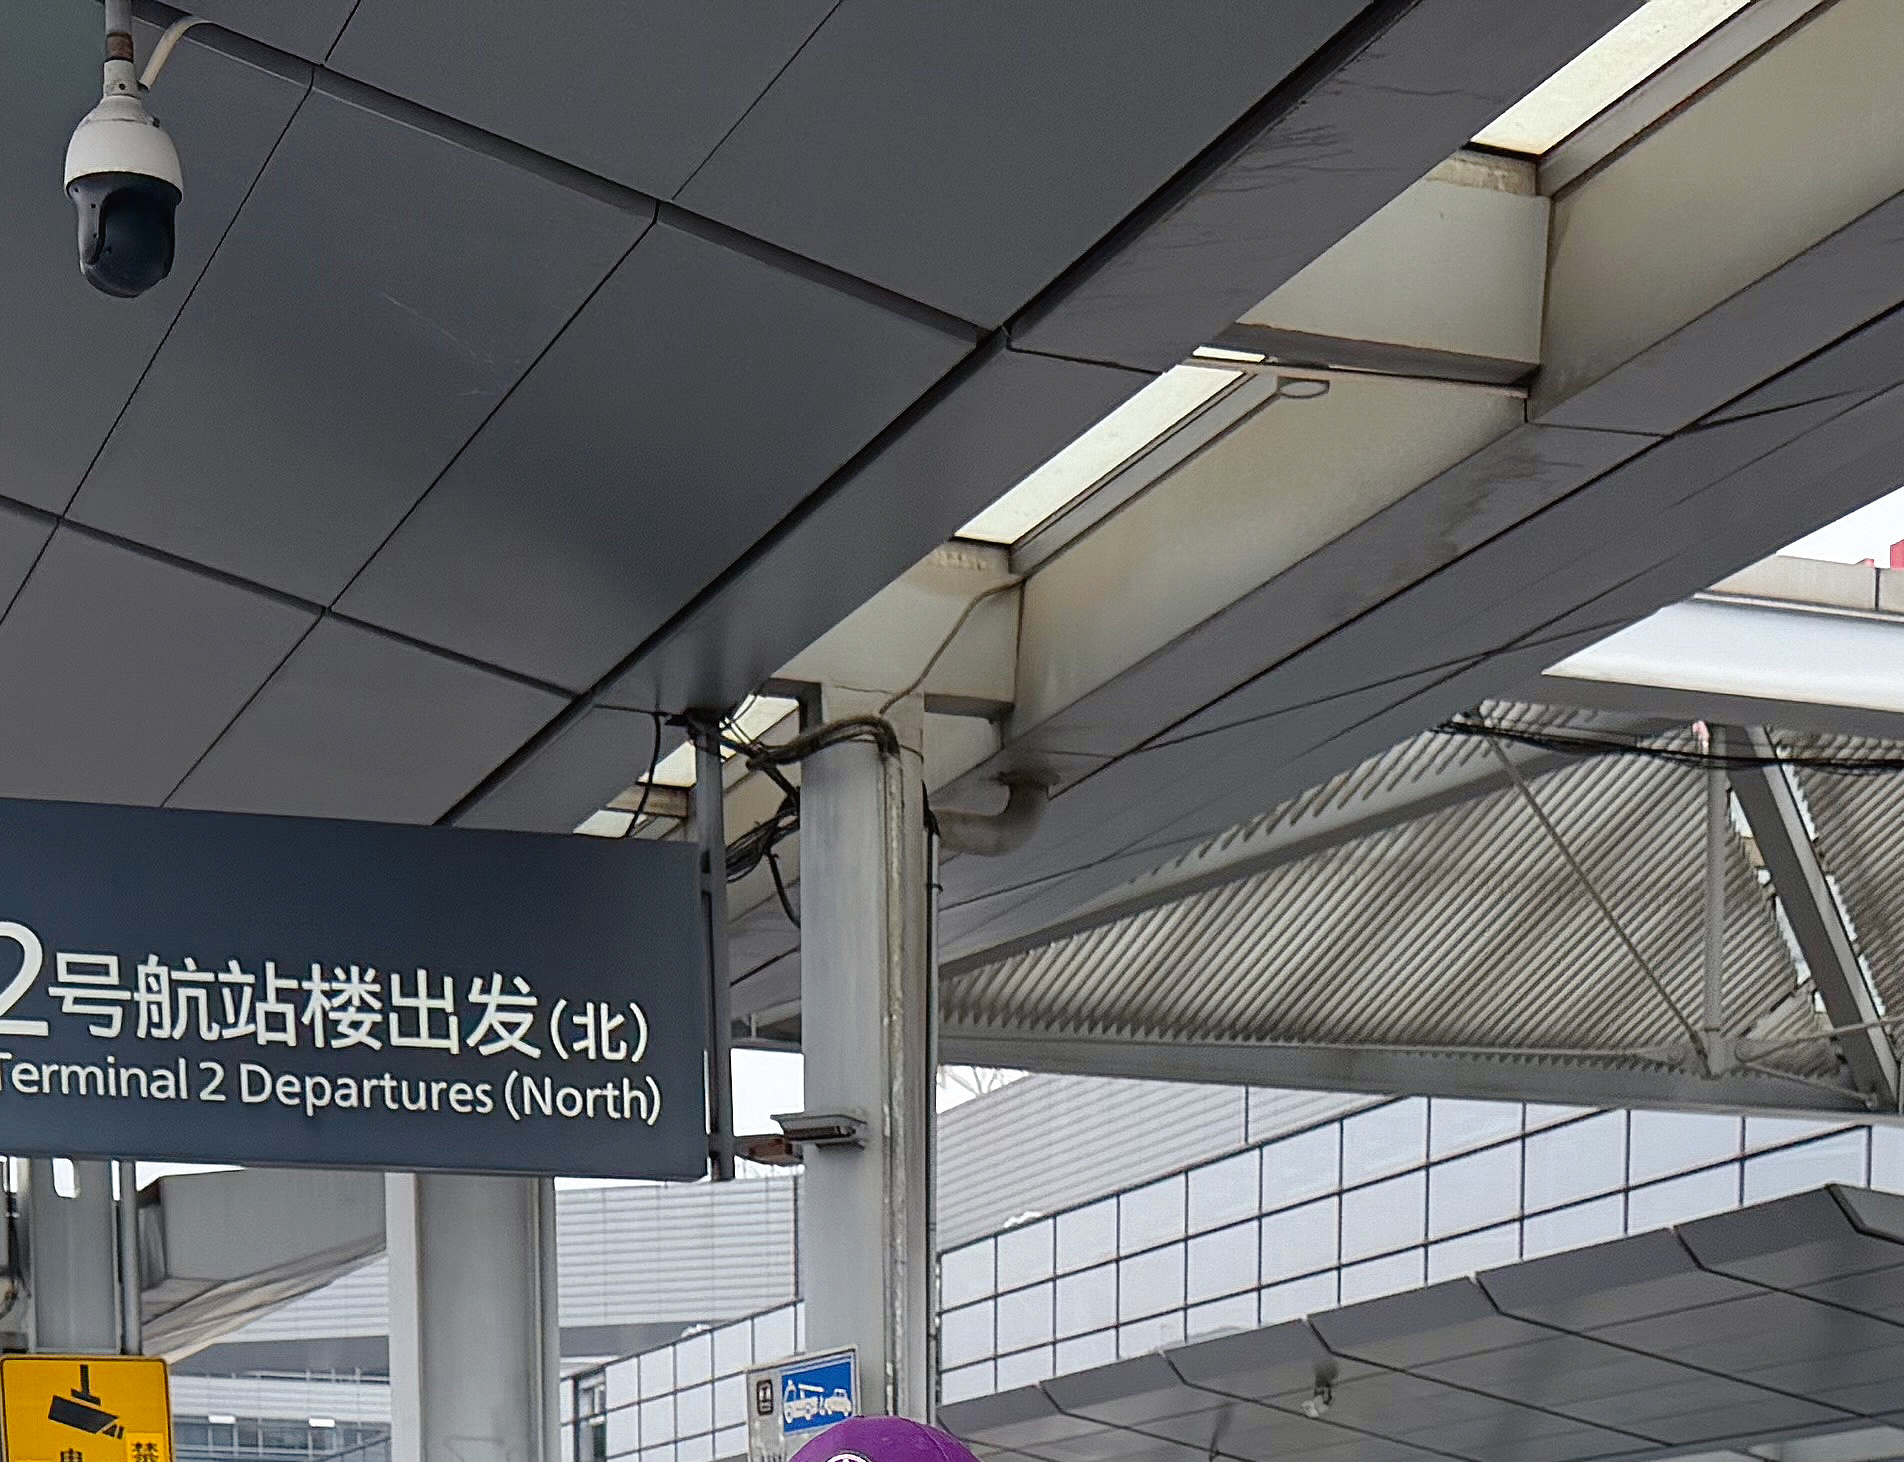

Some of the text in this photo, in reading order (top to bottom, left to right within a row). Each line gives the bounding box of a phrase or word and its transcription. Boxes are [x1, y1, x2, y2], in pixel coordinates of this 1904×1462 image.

[201, 1061, 229, 1102] 2
[239, 1063, 494, 1118] Departures
[503, 1070, 664, 1126] (North)
